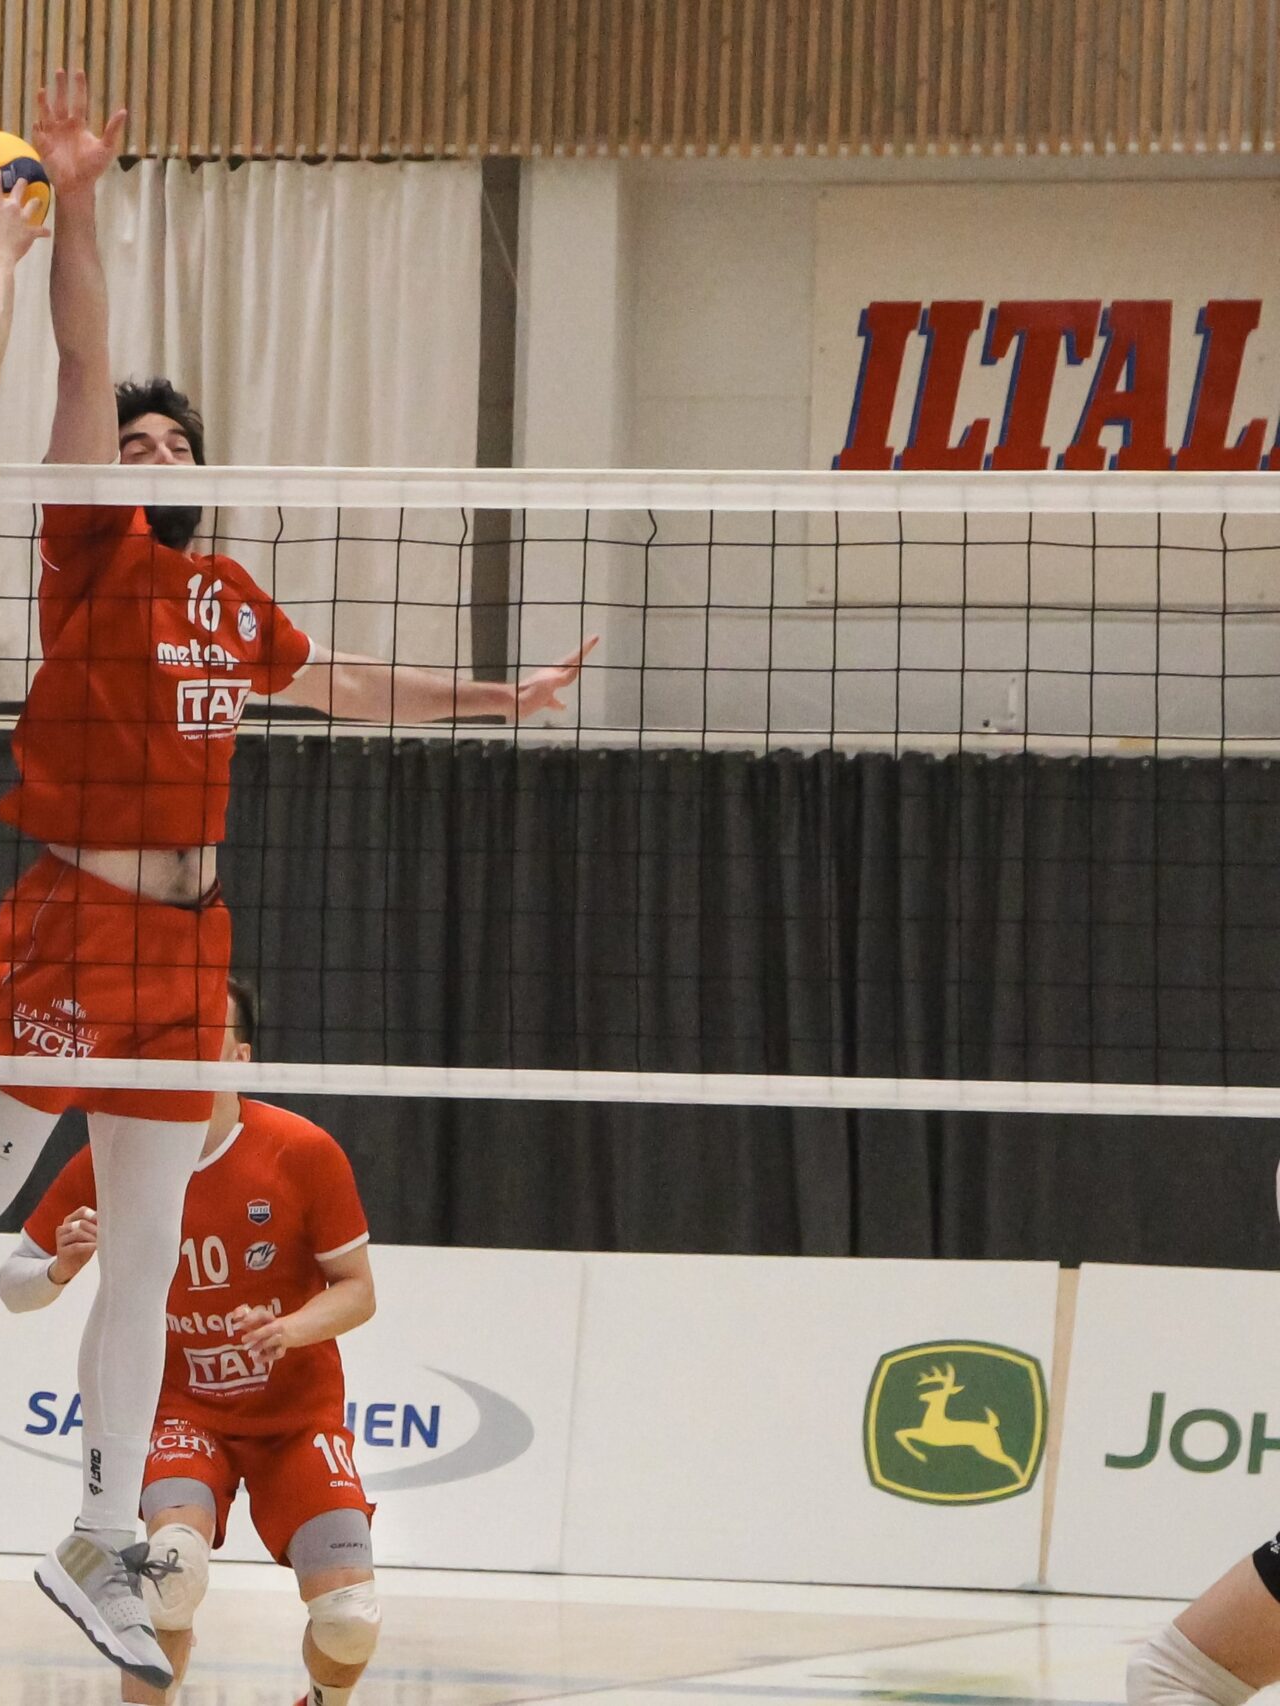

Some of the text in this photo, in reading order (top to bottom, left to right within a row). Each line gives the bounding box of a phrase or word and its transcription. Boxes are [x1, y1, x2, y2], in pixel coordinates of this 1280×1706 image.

[831, 299, 1280, 471] ILTAL
[187, 573, 223, 632] 16
[181, 1236, 229, 1286] 10
[313, 1433, 354, 1478] 10
